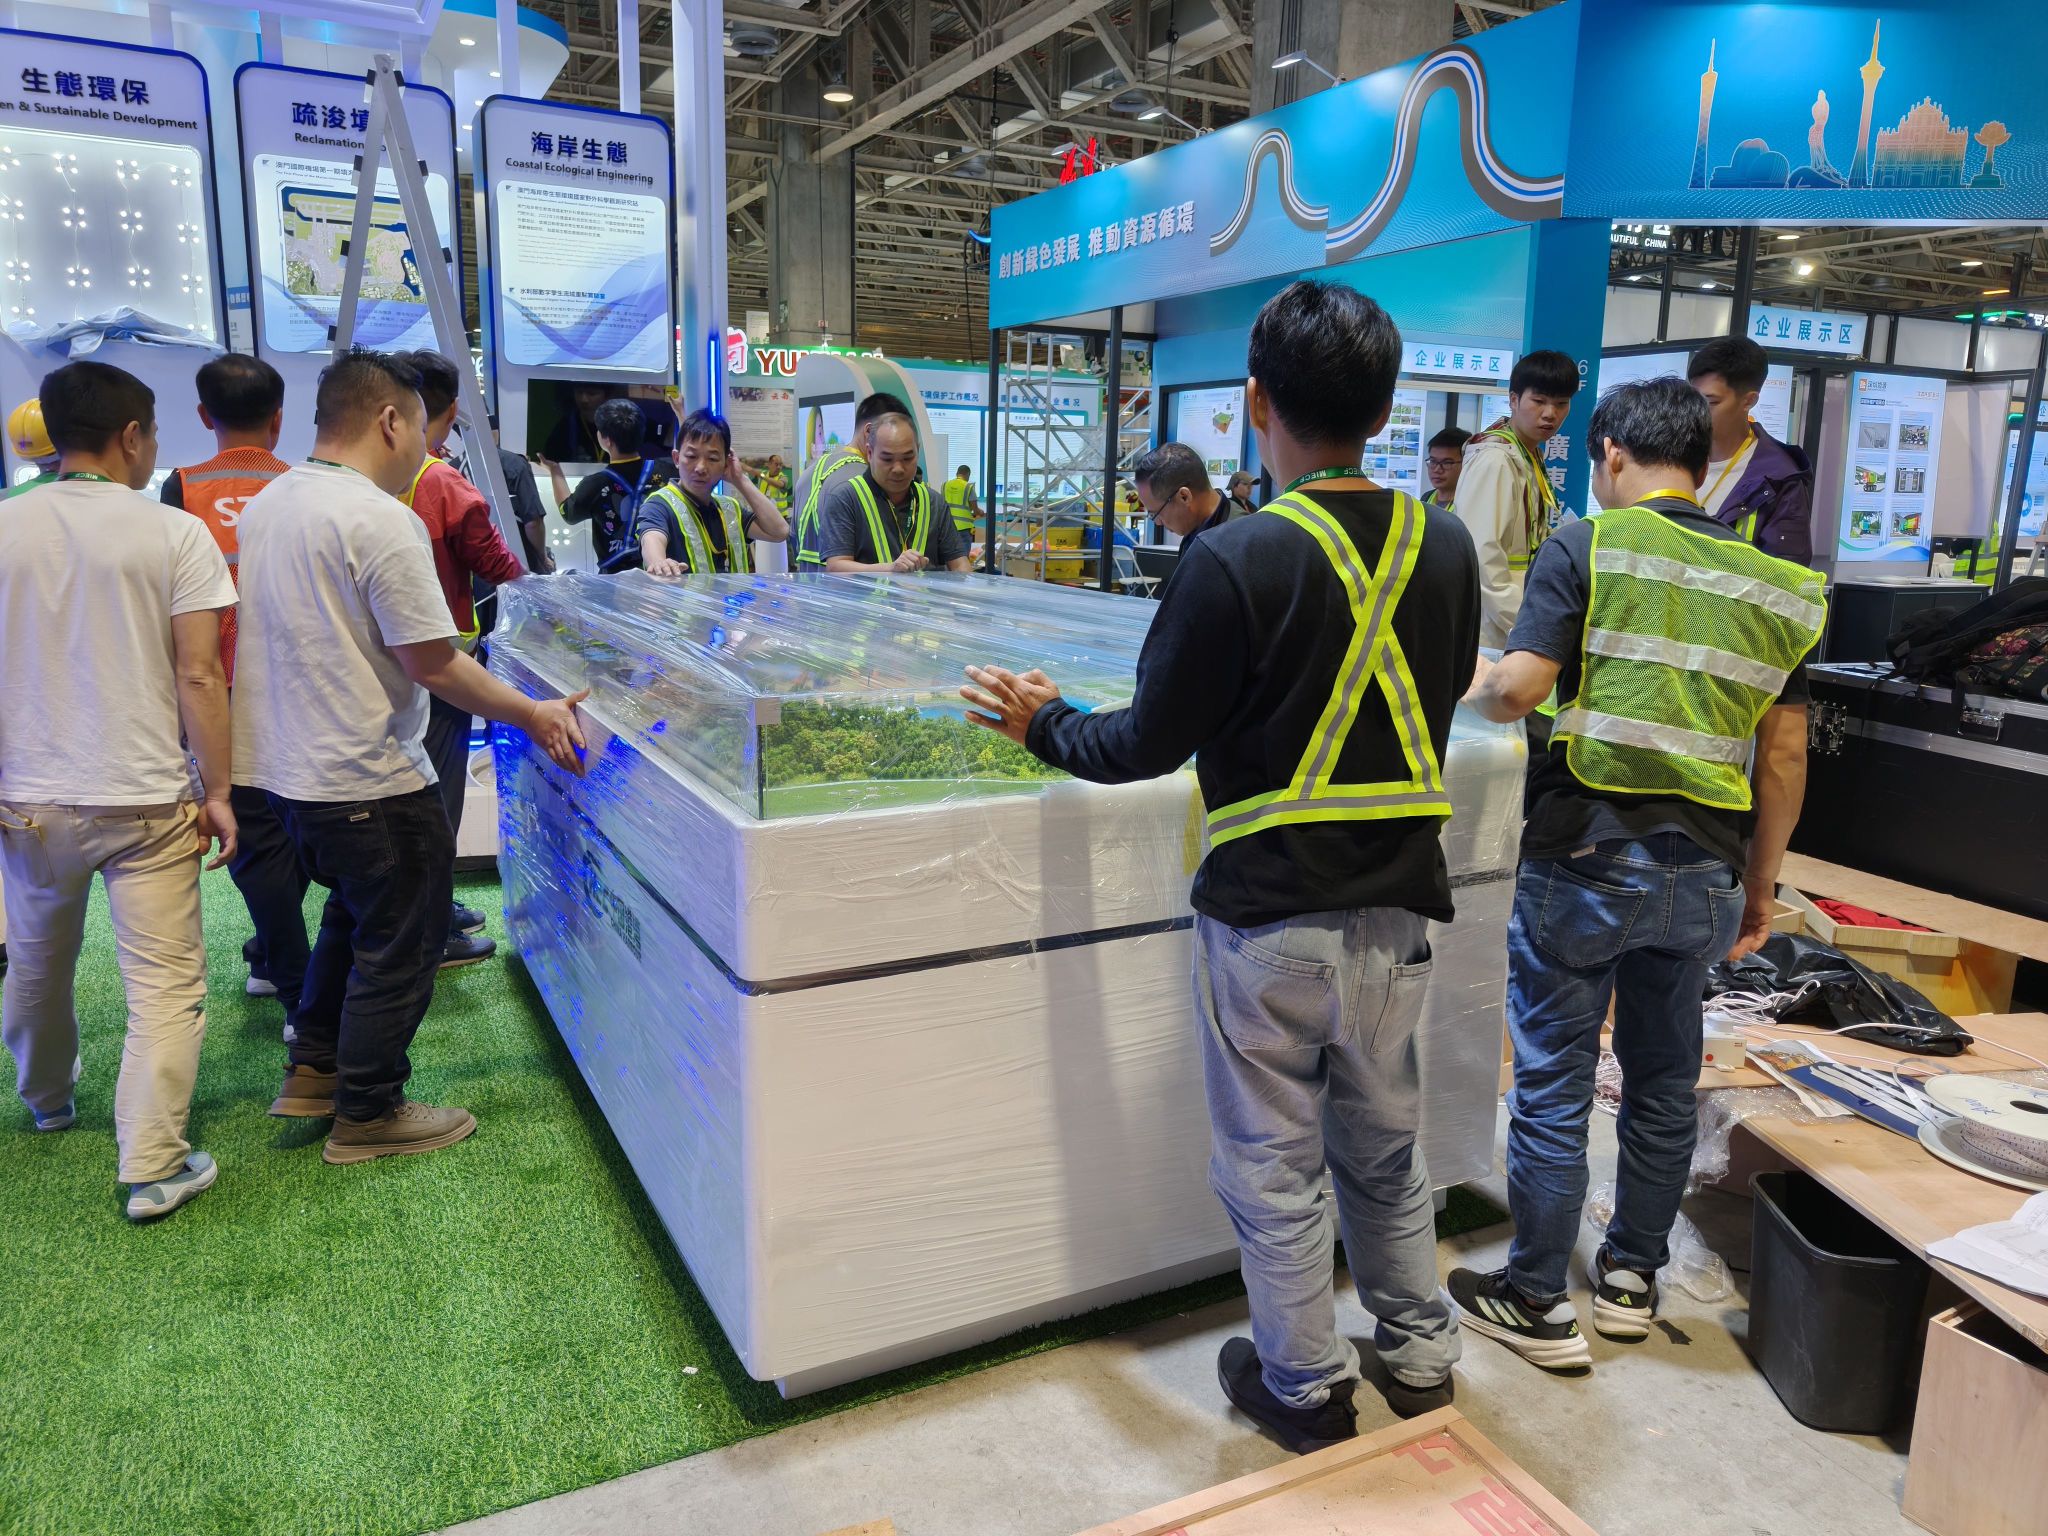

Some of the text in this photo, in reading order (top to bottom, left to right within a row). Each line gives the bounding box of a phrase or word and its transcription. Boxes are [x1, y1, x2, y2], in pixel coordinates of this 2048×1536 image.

[21, 67, 151, 106] 生態環保
[18, 102, 31, 112] &
[34, 103, 110, 120] Sustainable
[113, 111, 199, 130] Development
[294, 132, 365, 150] Reclamation
[531, 131, 629, 164] 海岸生態
[505, 157, 654, 185] Coastal Ecological Engineering
[998, 200, 1196, 279] 創新綠色發展 推動資源循環
[1644, 237, 1668, 249] CHINA
[1754, 313, 1854, 345] 企业展示区
[1415, 349, 1502, 372] 企业展示区
[1300, 469, 1327, 483] MIECF
